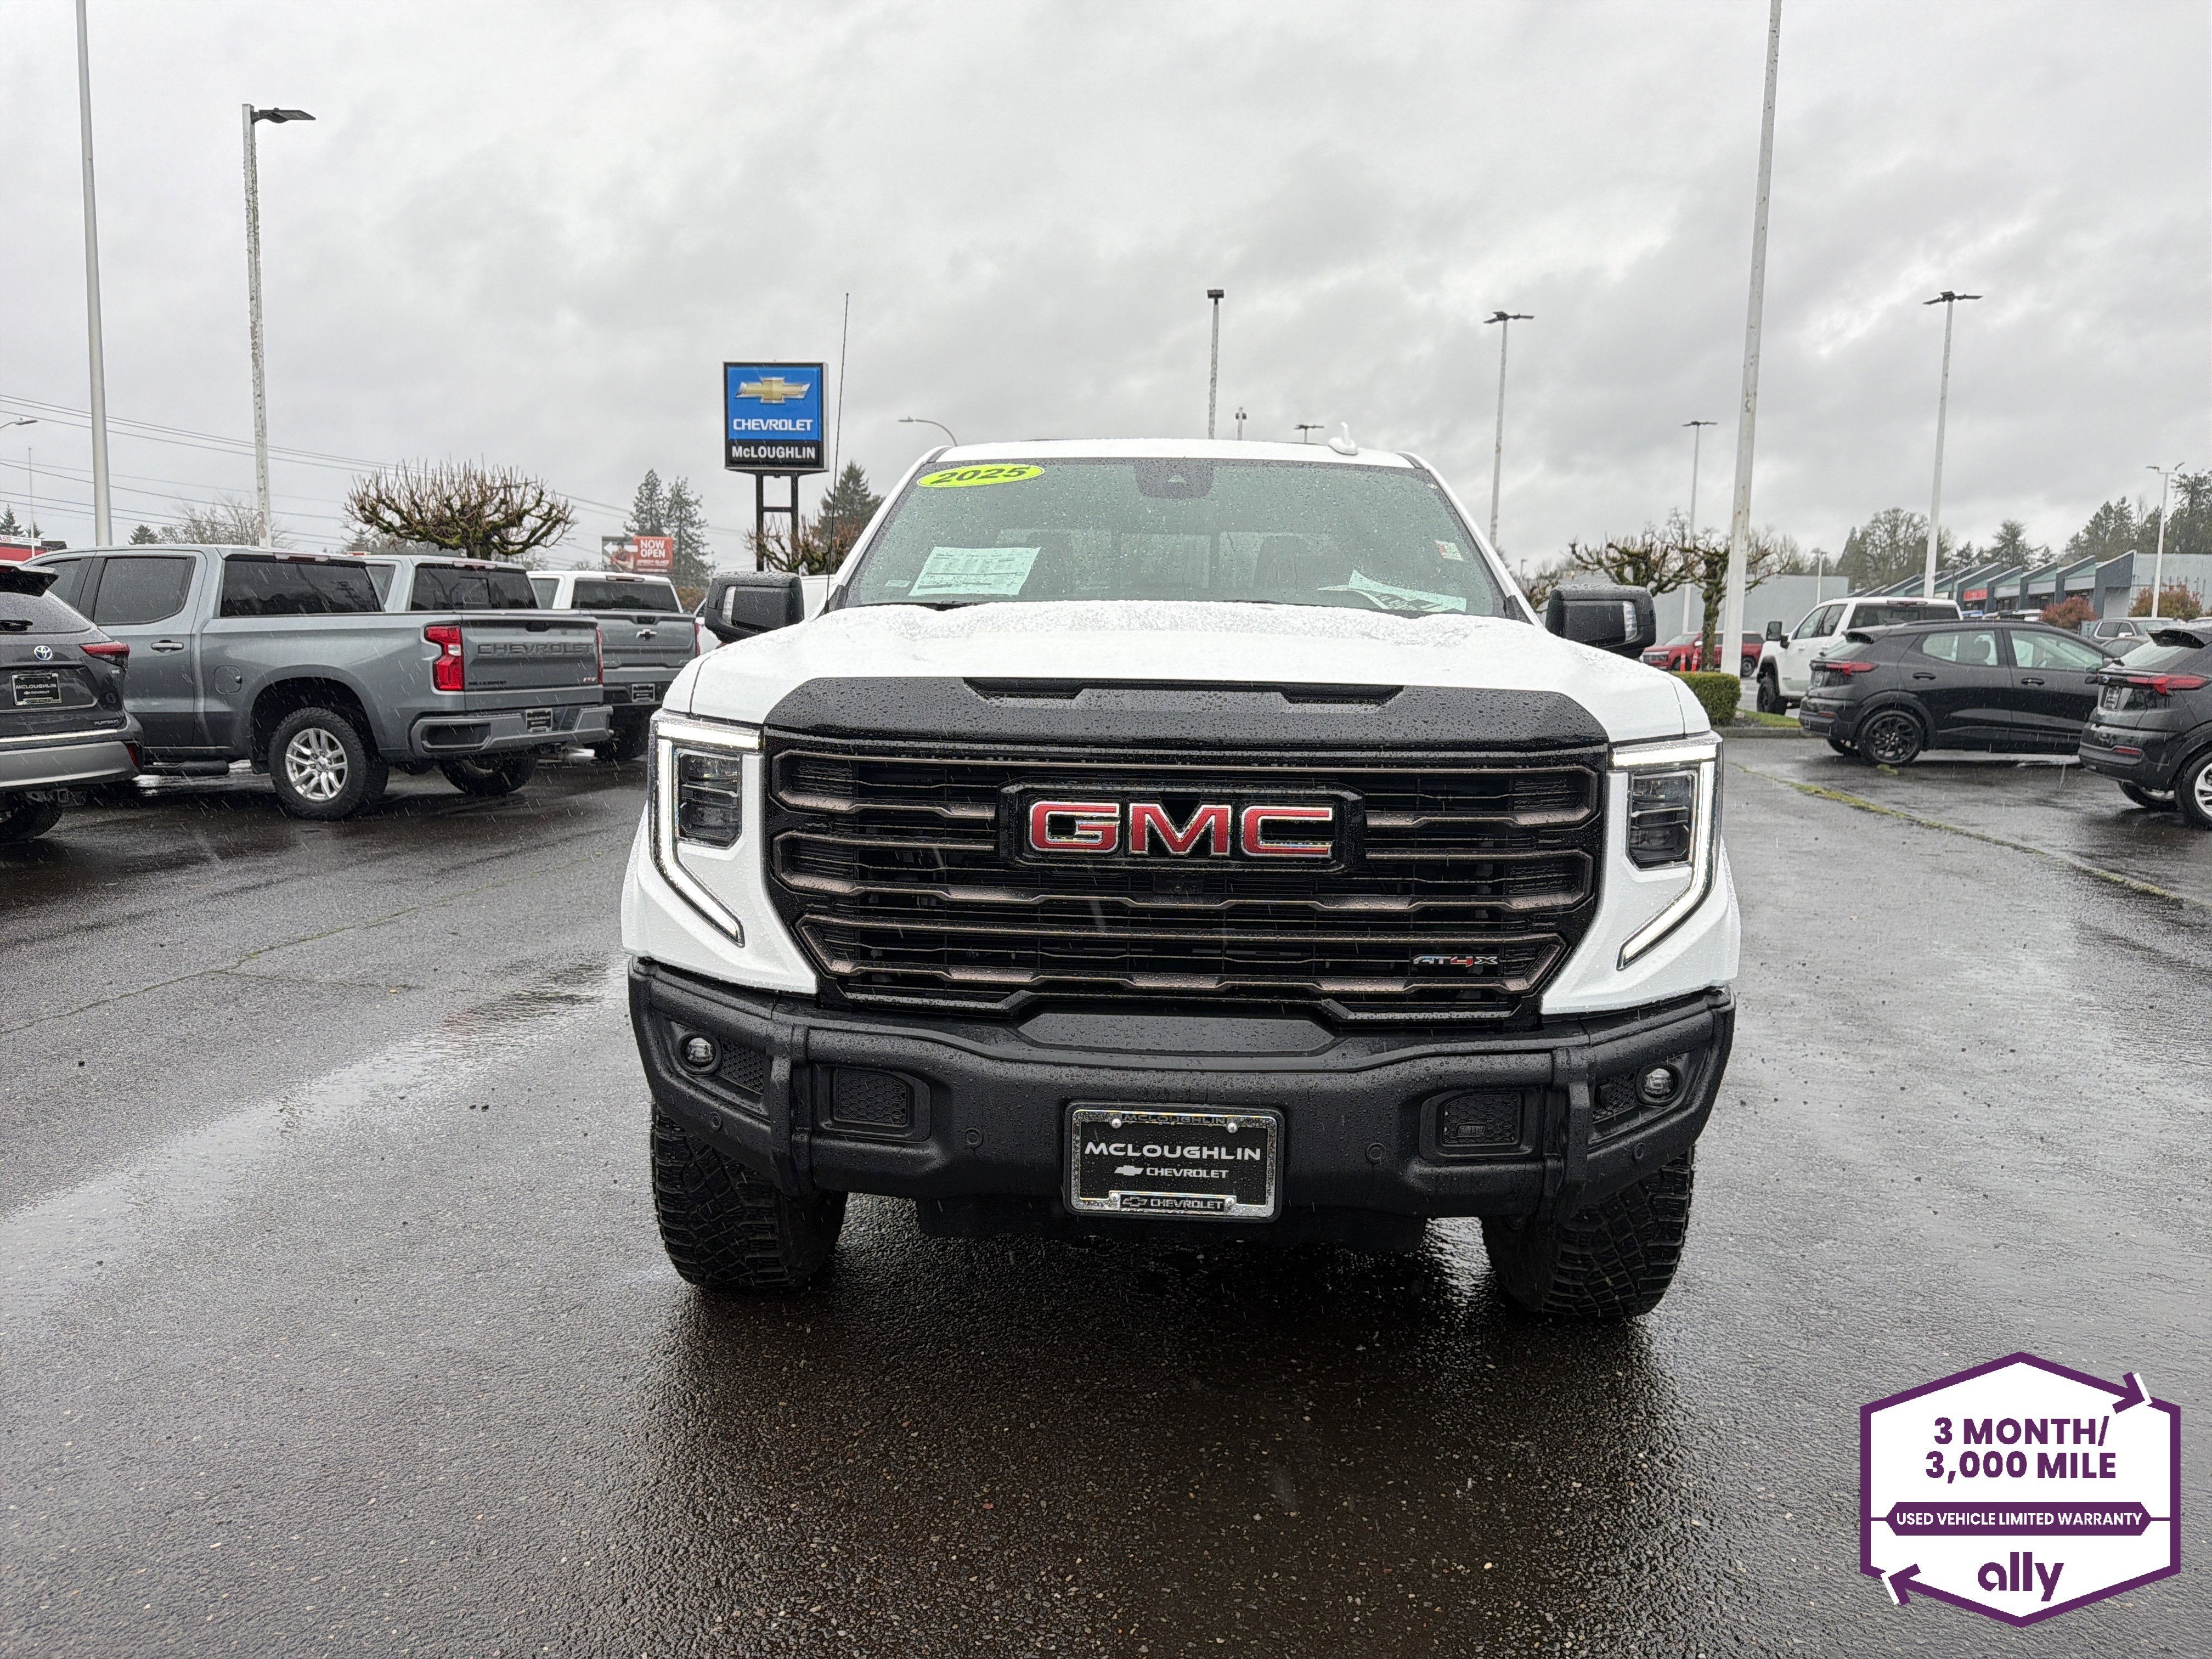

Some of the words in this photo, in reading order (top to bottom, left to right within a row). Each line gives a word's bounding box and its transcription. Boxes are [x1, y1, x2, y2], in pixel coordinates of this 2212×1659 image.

[733, 419, 813, 431] CHEVROLET
[732, 445, 816, 459] McLOUGHLIN
[930, 467, 1031, 484] 2025
[640, 539, 665, 549] NOW
[640, 549, 665, 558] OPEN
[477, 644, 594, 656] CHEVROLET
[1029, 800, 1333, 857] GMC
[1413, 956, 1498, 968] AT4X
[1125, 1114, 1225, 1124] MCLOUGHLIN
[1084, 1142, 1261, 1161] MCLOUGHLIN
[1146, 1167, 1229, 1178] CHEVROLET
[1150, 1198, 1223, 1210] CHEVROLET
